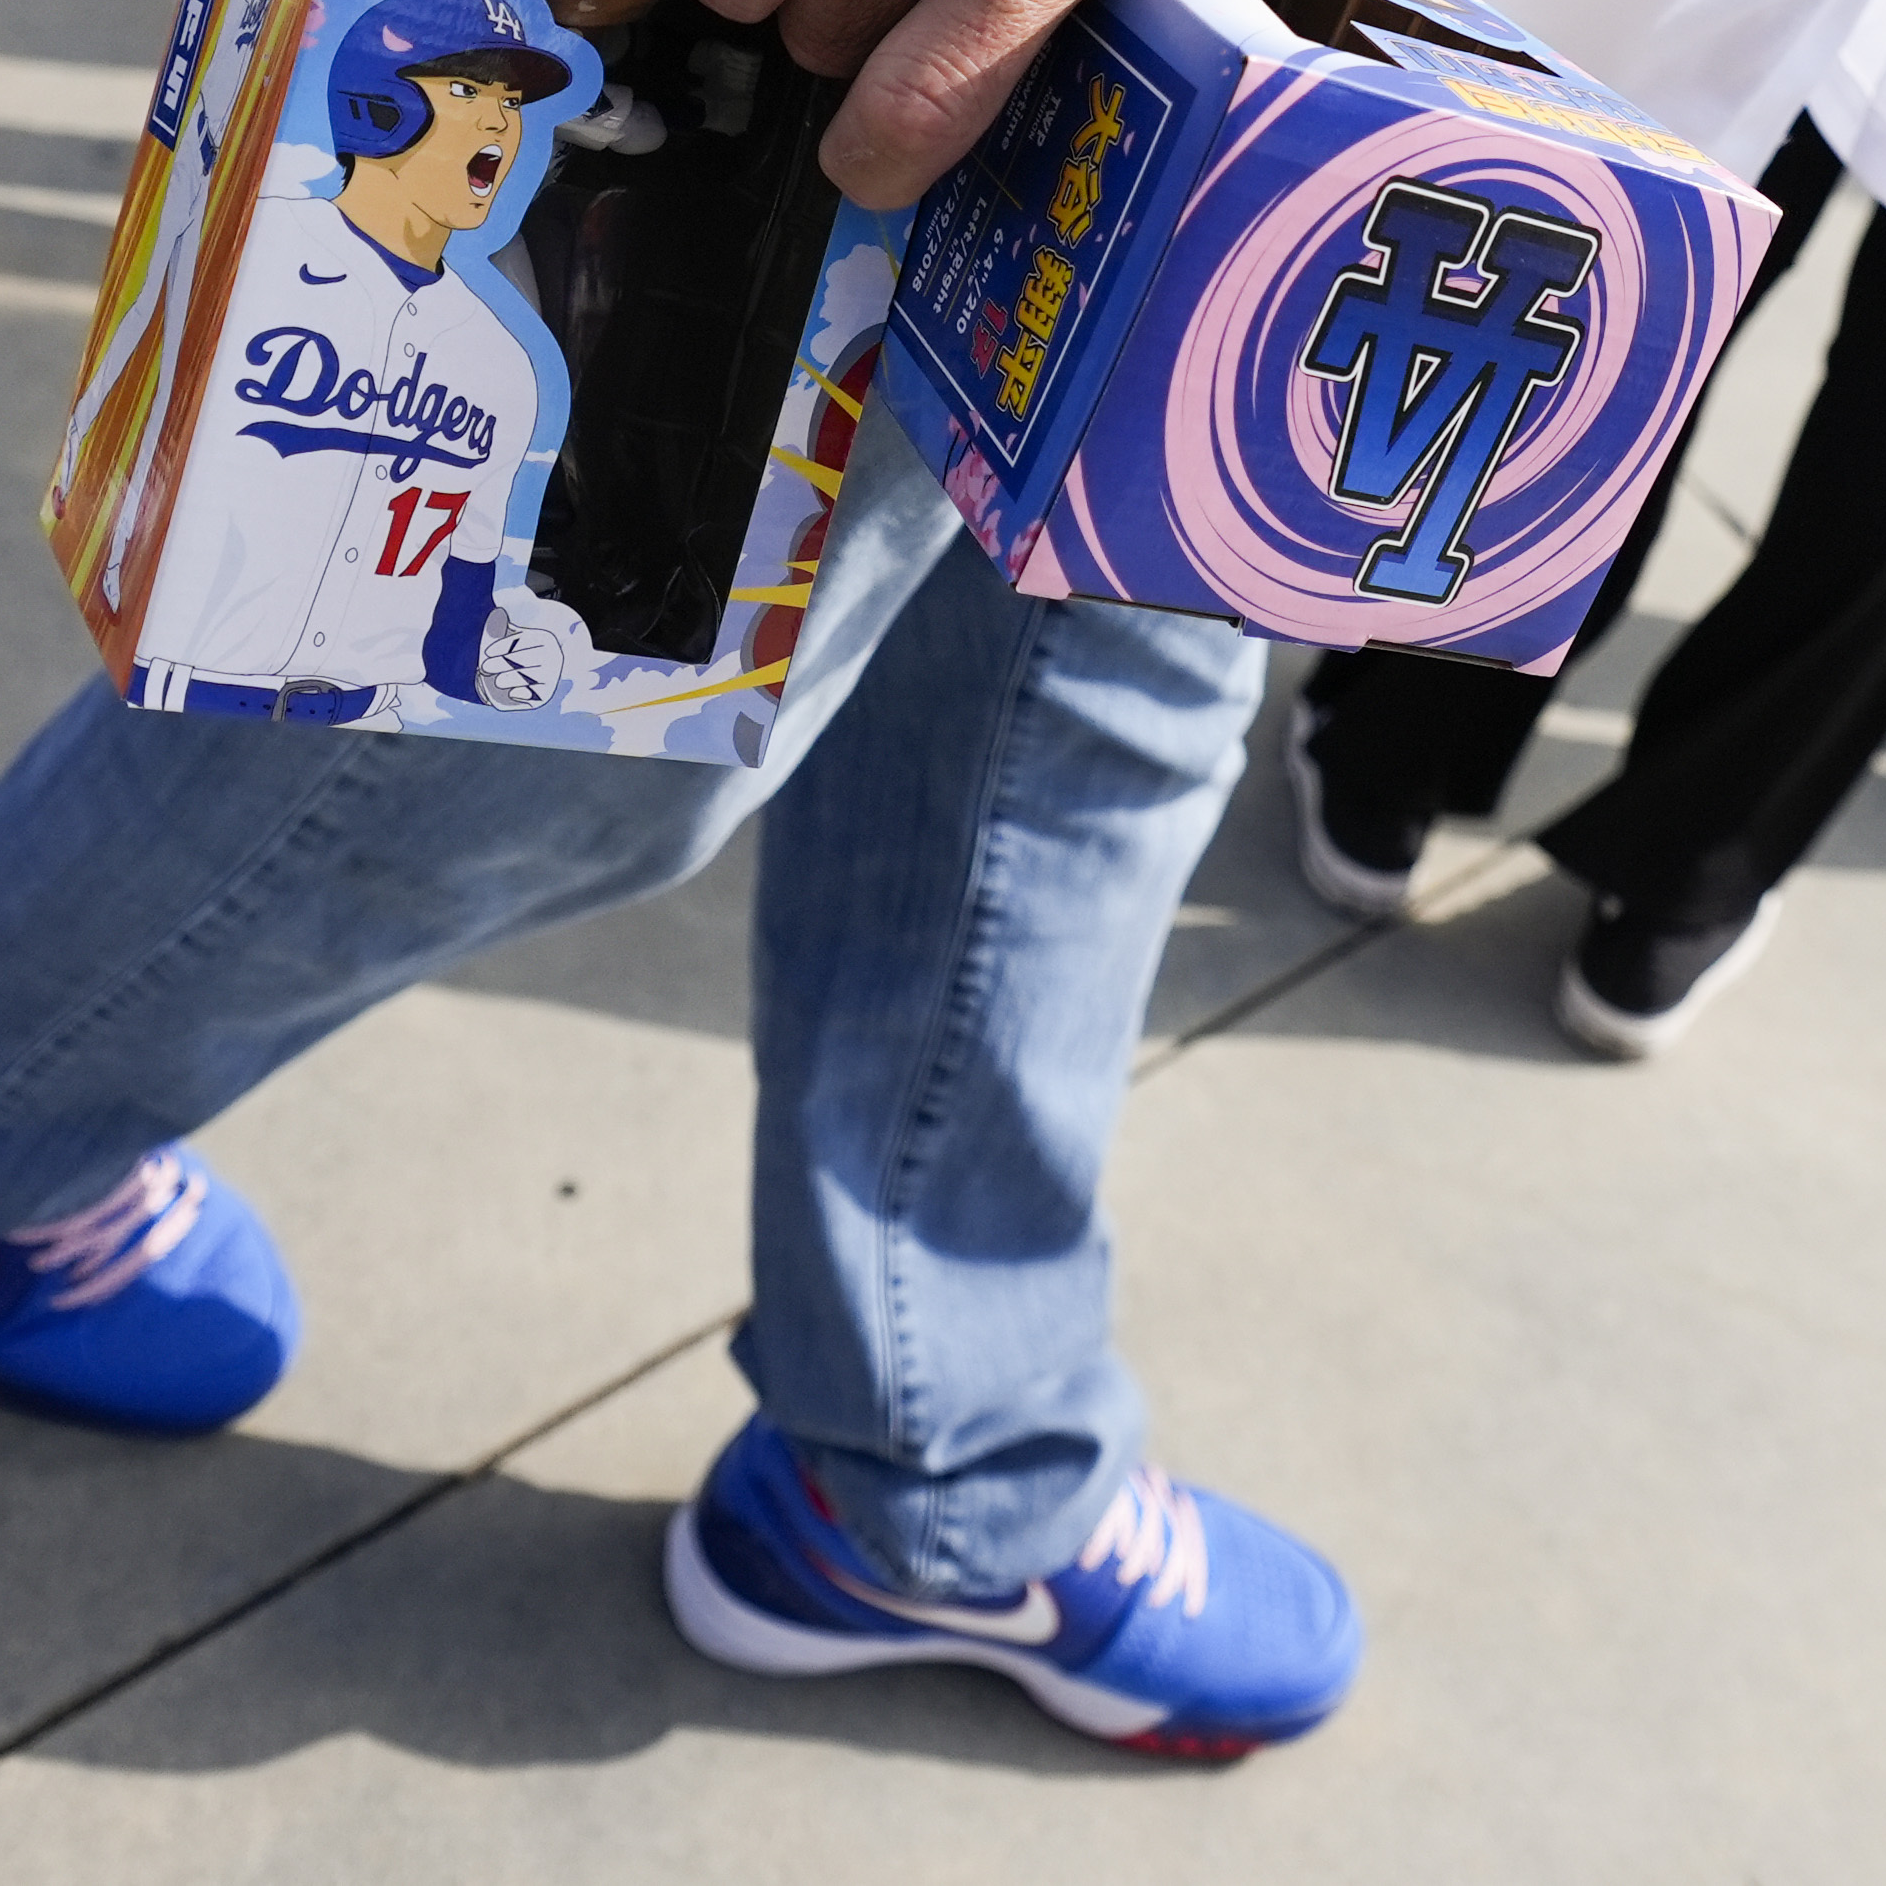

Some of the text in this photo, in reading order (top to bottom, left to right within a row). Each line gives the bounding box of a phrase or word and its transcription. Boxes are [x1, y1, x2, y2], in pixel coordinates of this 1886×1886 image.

[1036, 95, 1063, 147] TWP
[911, 168, 970, 294] 3/29/2018
[932, 195, 989, 315] Left/Right
[995, 71, 1126, 422] 大谷 翔平
[969, 297, 1009, 380] 17
[1298, 176, 1602, 607] LA
[235, 326, 496, 484] Dodgers
[374, 486, 471, 578] 17
